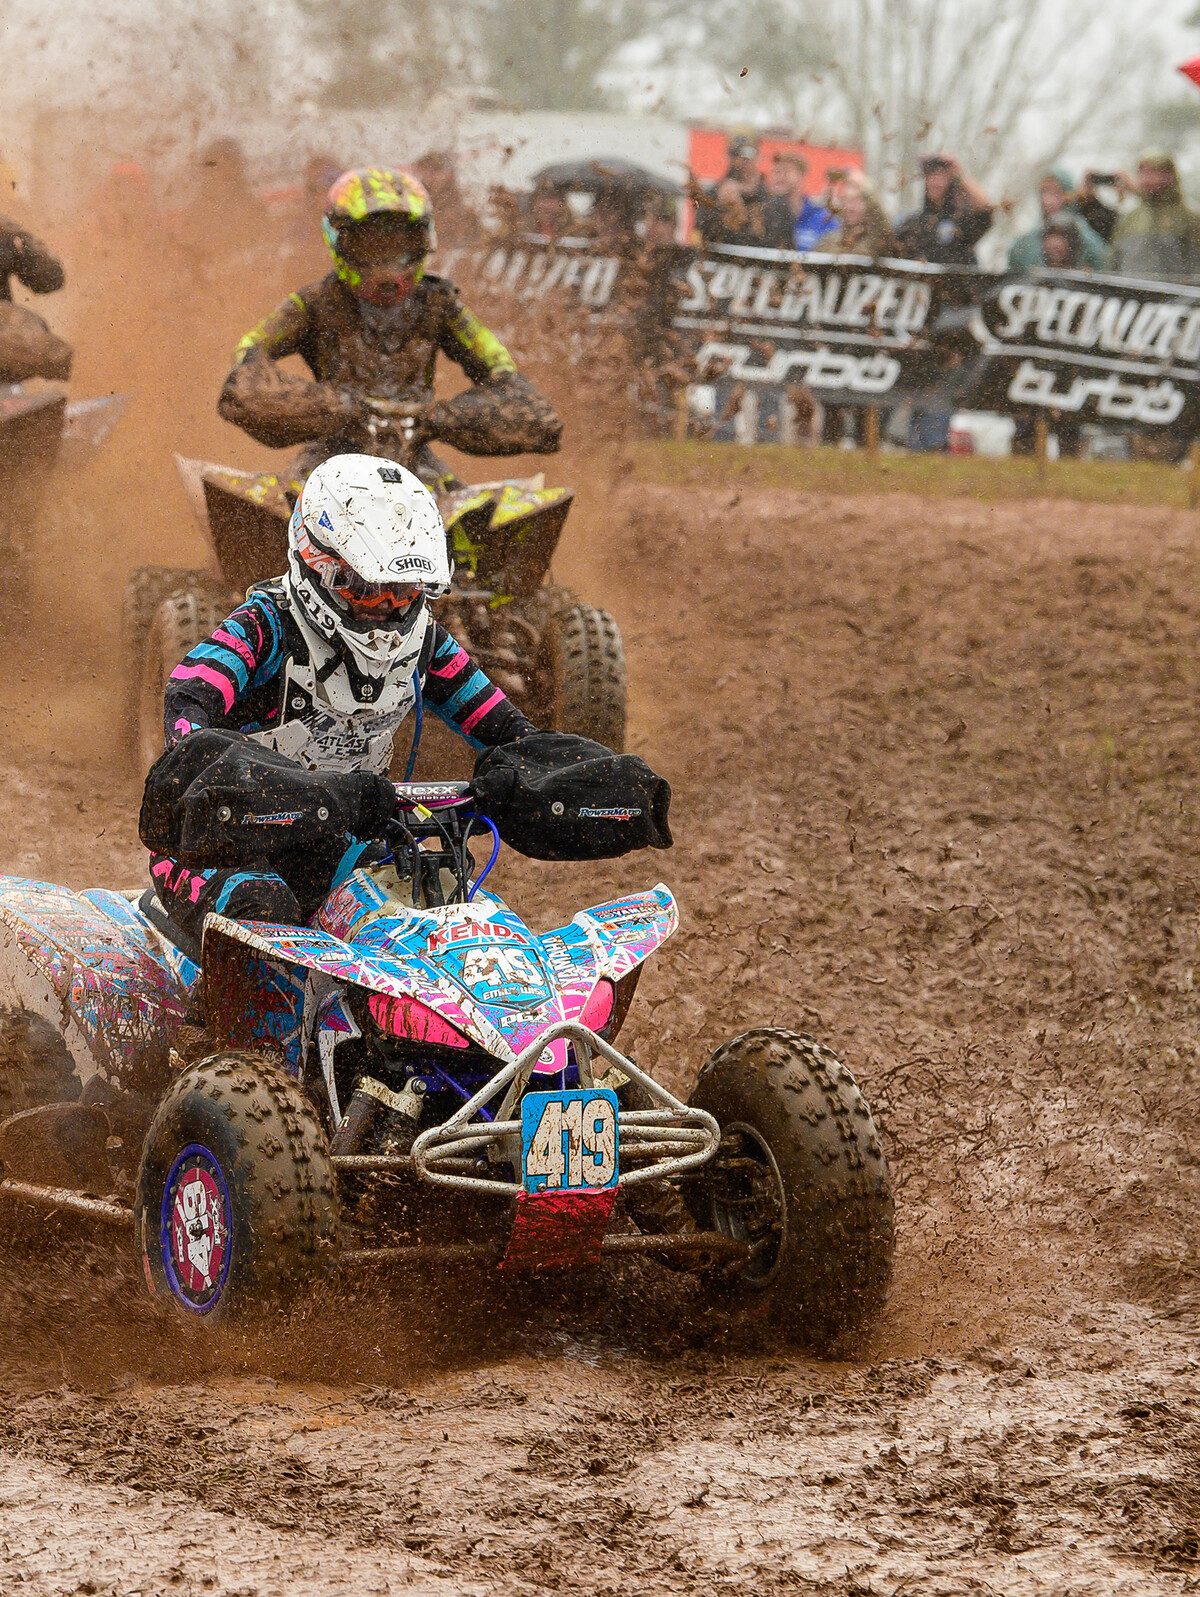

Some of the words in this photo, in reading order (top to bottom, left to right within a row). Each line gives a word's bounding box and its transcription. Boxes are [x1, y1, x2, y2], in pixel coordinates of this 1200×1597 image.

[1008, 360, 1186, 425] turbo
[395, 559, 432, 573] SHOEI
[298, 589, 337, 630] 419
[317, 735, 365, 749] ATLAS
[428, 923, 529, 951] KENDA
[461, 945, 545, 987] 419
[526, 1098, 616, 1188] 419
[182, 1180, 211, 1277] 419
